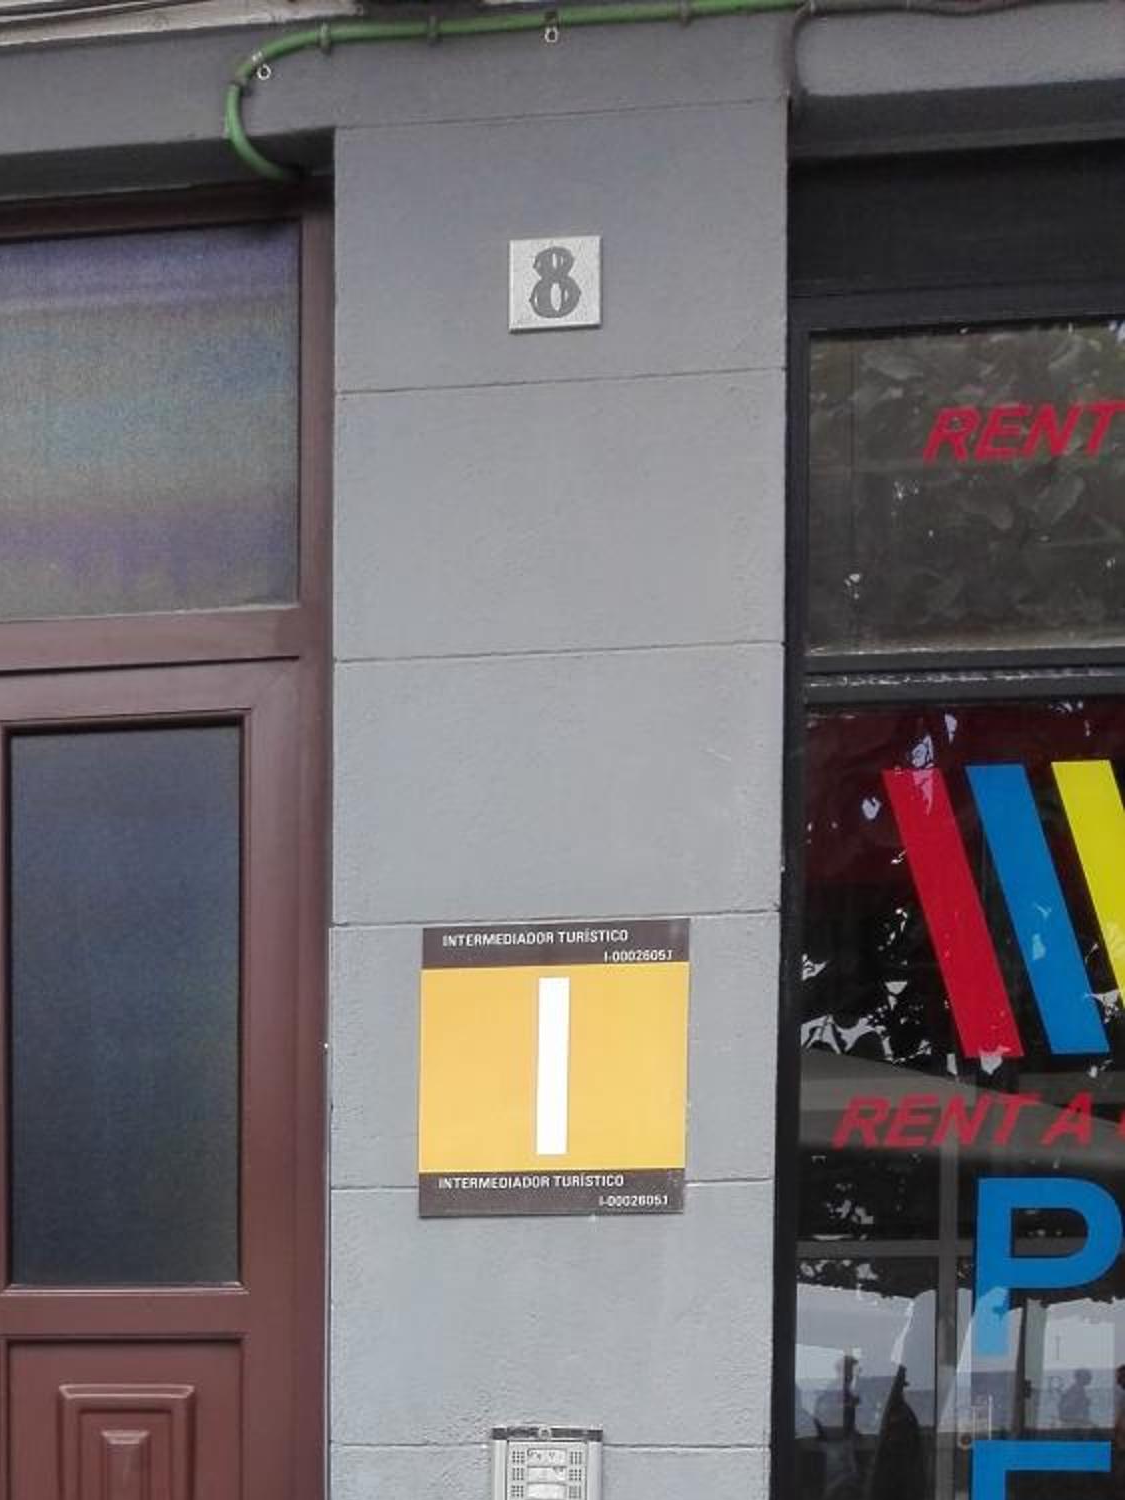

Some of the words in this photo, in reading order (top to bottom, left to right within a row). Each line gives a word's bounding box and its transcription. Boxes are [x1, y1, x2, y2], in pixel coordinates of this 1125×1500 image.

[528, 245, 582, 319] 8
[922, 397, 1125, 462] RENT
[442, 931, 554, 948] INTERMEDIADOR
[558, 928, 629, 944] TURÍSTICO
[831, 1090, 1043, 1150] RENT
[1040, 1089, 1094, 1146] A
[438, 1175, 550, 1190] INTERMEDIADOR
[554, 1173, 625, 1188] TURÍSTICO
